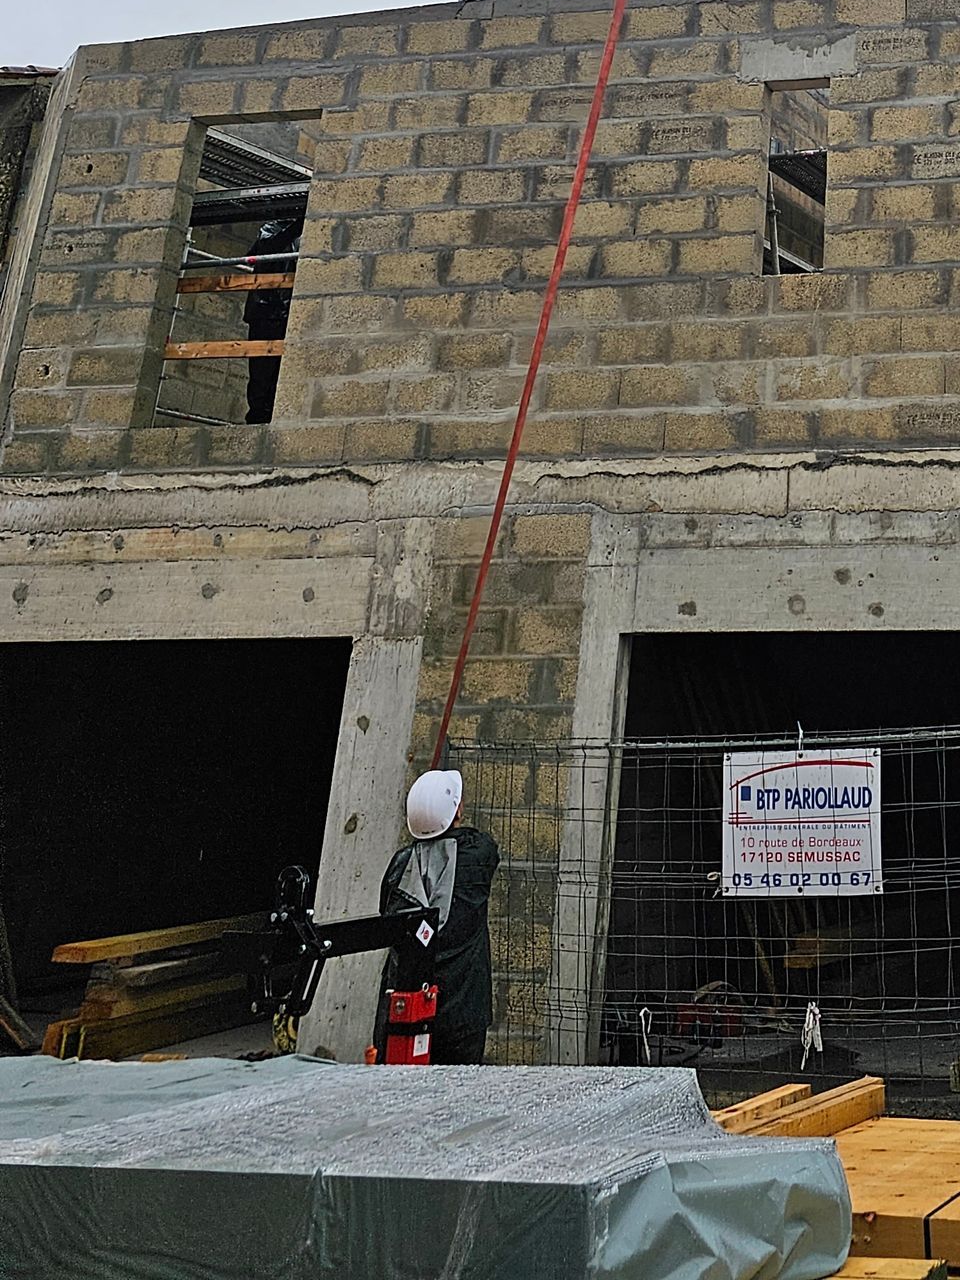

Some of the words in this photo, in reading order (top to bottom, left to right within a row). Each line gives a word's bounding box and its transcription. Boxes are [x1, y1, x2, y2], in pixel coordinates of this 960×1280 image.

[756, 788, 780, 810] BTP
[785, 786, 873, 810] PARIOLLAUD
[741, 837, 754, 848] 10
[759, 838, 788, 848] route
[792, 837, 804, 847] de
[809, 837, 862, 847] Bordeaux
[741, 852, 783, 863] 17120
[788, 852, 861, 862] SEMUSSAC
[732, 873, 752, 886] 05
[761, 873, 781, 886] 46
[790, 873, 811, 886] 02
[820, 873, 841, 886] 00
[850, 873, 871, 886] 67
